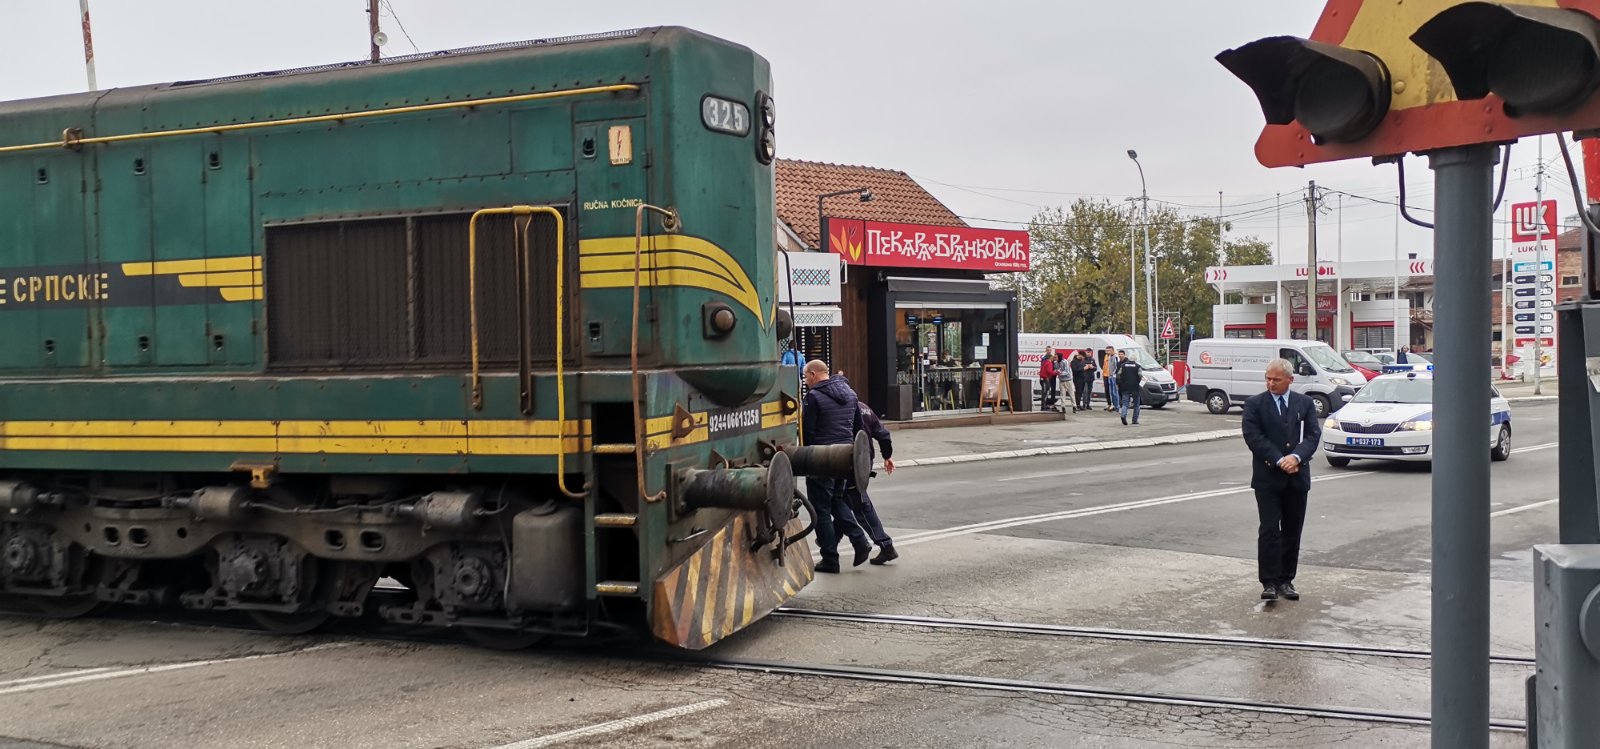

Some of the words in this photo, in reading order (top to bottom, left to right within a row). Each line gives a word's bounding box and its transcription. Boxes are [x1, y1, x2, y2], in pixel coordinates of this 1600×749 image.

[709, 100, 743, 130] 325
[583, 200, 609, 210] RUČNA
[611, 198, 643, 208] KOČNICA
[1296, 265, 1336, 277] LUOIL
[13, 272, 109, 302] СРПСКЕ
[1018, 353, 1043, 364] xpress
